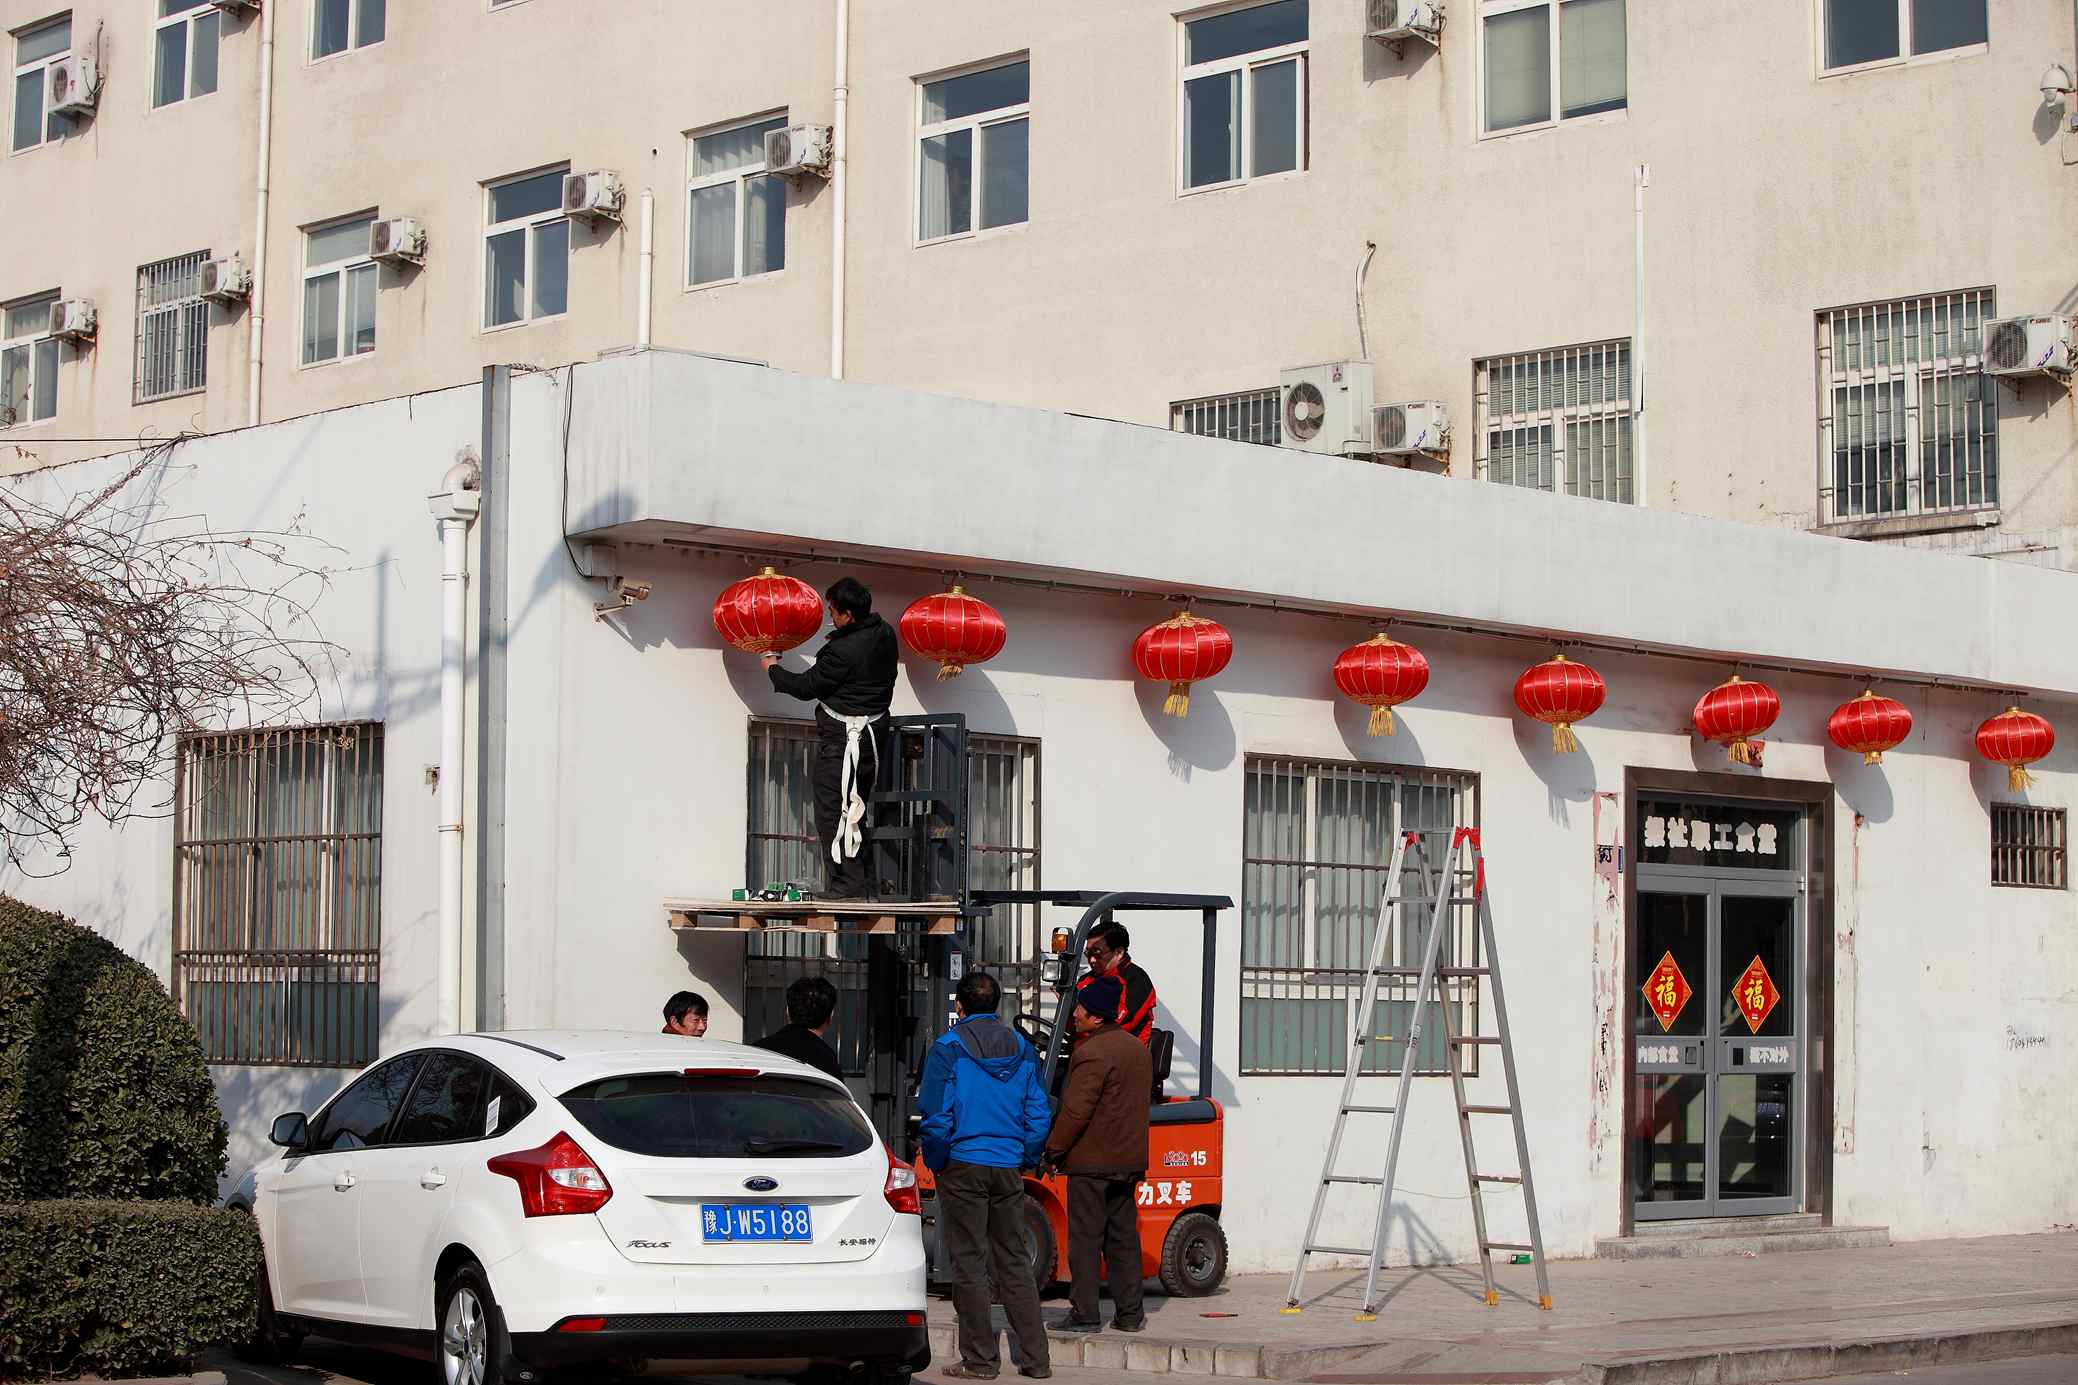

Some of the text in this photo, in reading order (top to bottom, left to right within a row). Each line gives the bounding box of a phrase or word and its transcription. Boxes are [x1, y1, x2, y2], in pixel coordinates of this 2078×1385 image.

[1655, 975, 1677, 1007] 福
[1744, 979, 1765, 1011] 福
[1190, 1150, 1207, 1166] 15
